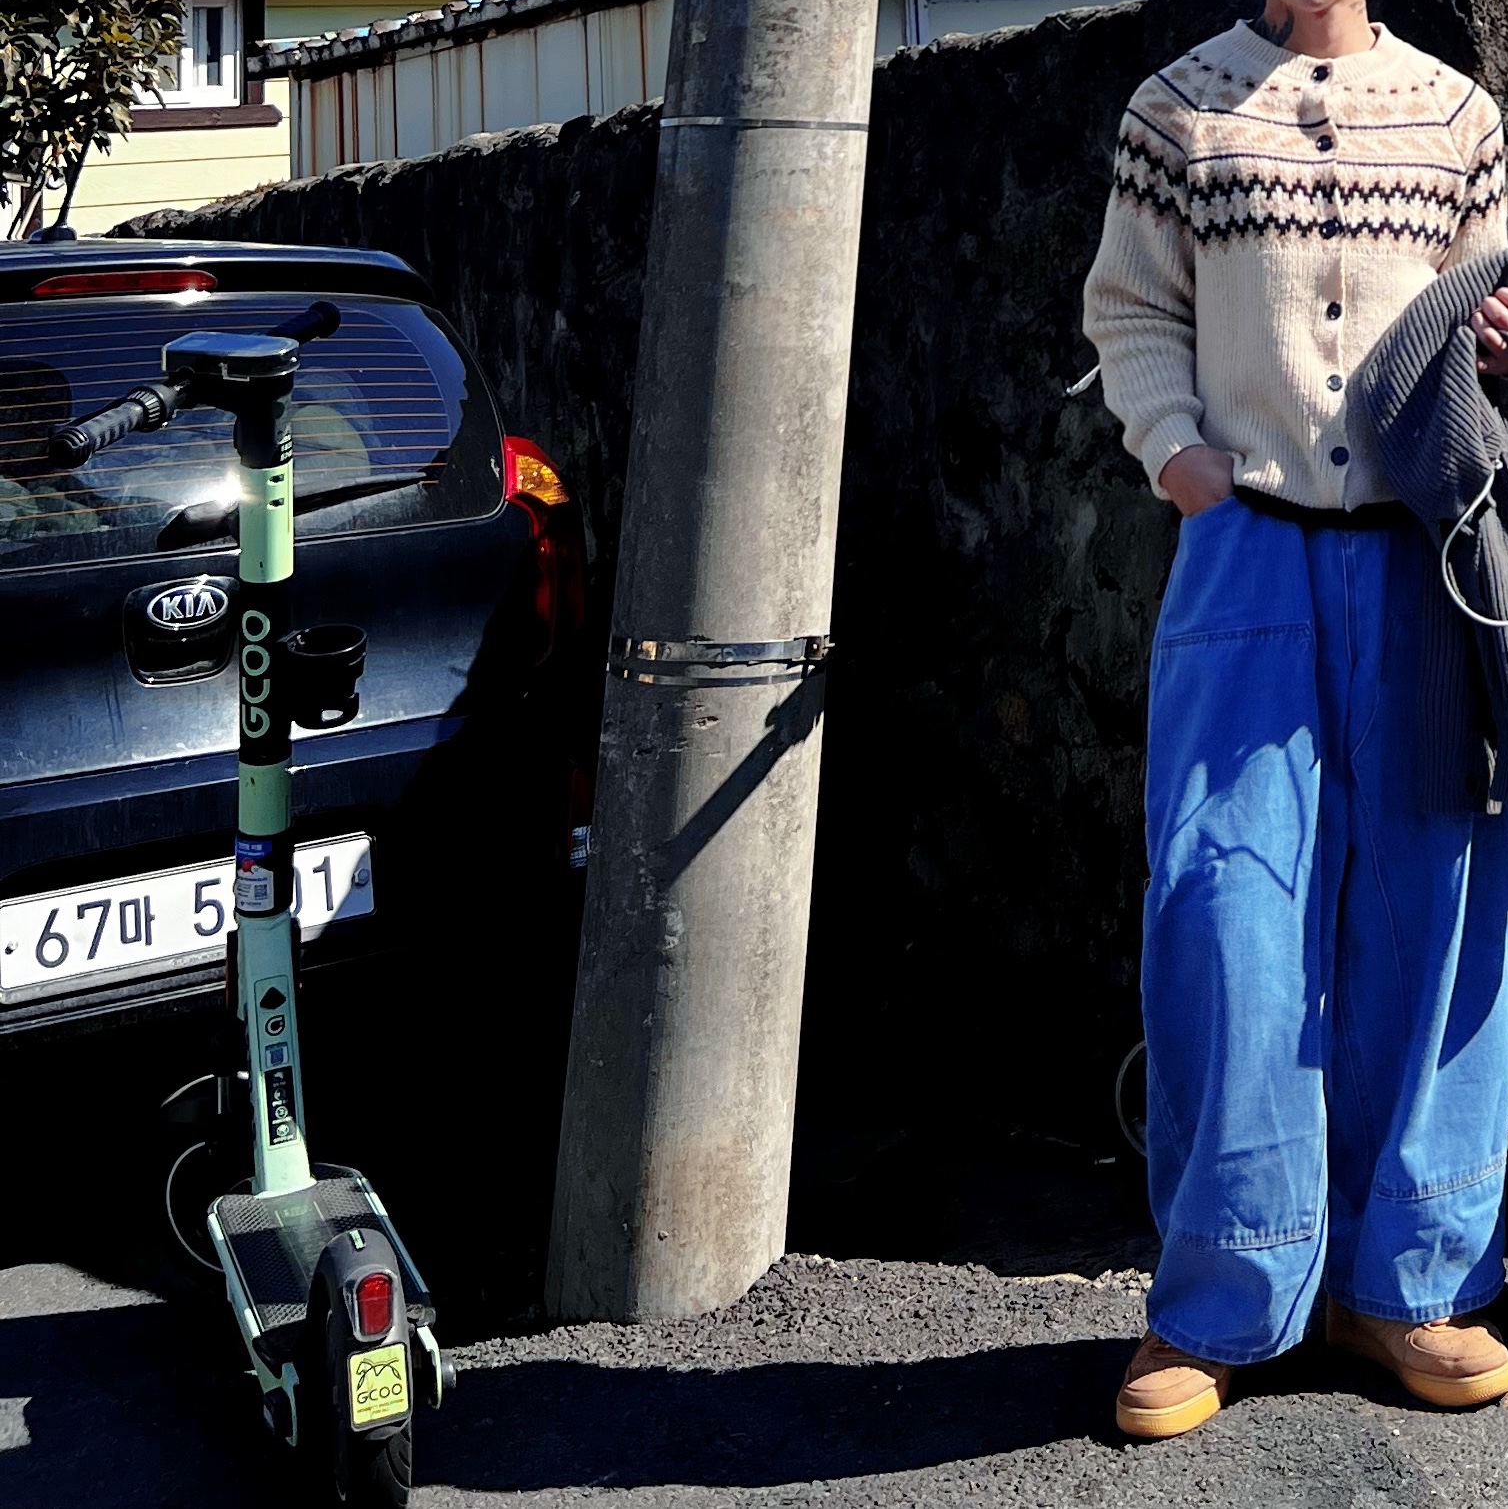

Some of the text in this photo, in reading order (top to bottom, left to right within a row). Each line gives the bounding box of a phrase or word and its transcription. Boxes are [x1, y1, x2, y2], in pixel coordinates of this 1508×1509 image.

[162, 591, 217, 621] KIA
[242, 610, 271, 739] GCOO
[35, 855, 334, 969] 67마 51
[356, 1383, 403, 1404] GCOO
